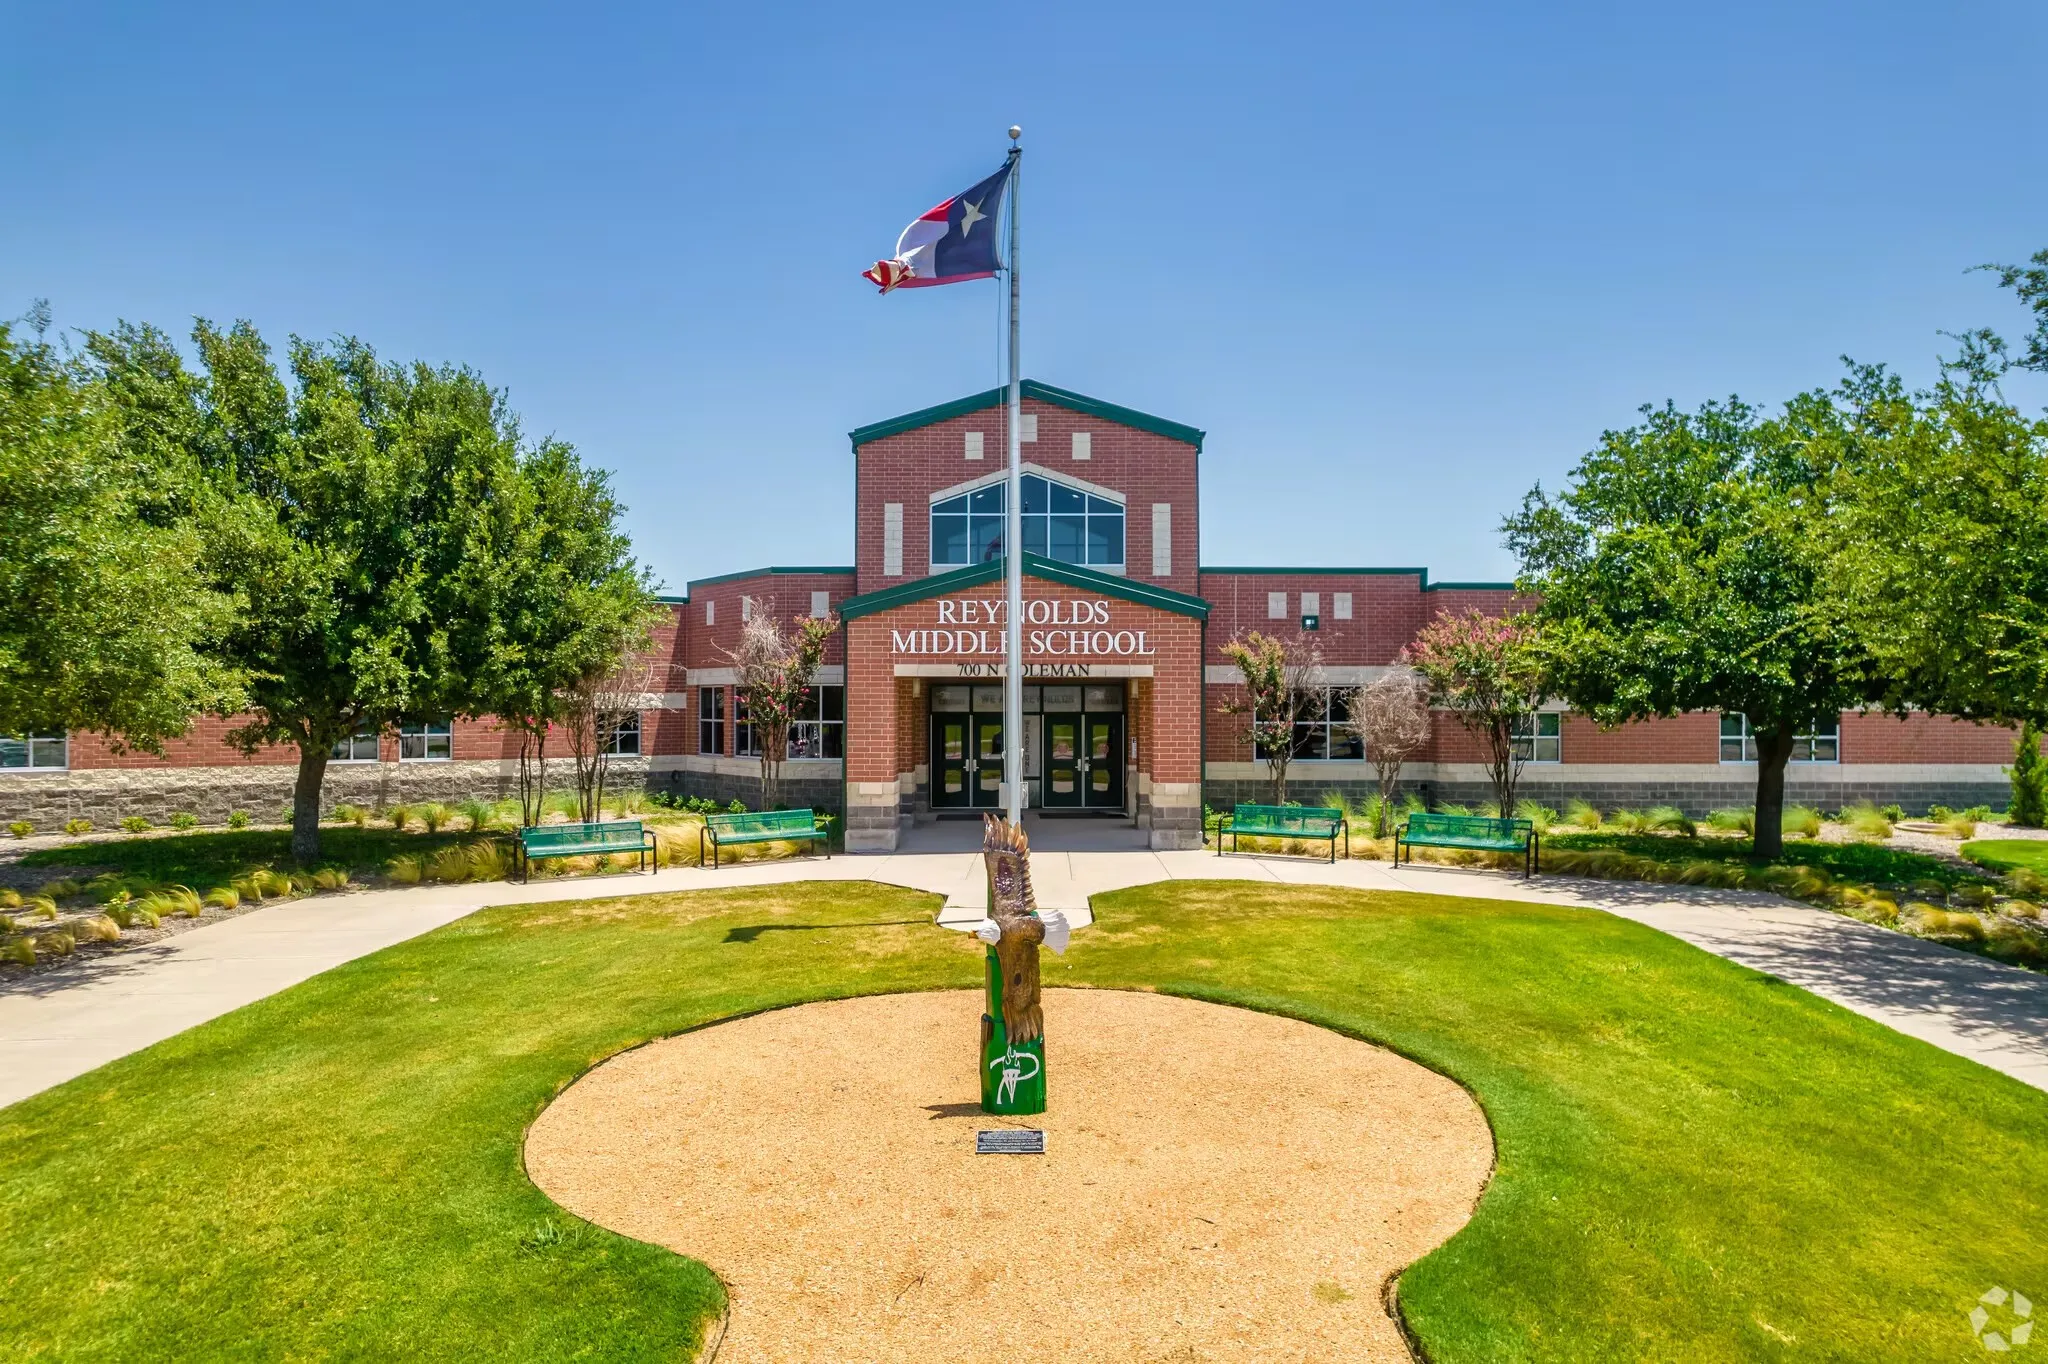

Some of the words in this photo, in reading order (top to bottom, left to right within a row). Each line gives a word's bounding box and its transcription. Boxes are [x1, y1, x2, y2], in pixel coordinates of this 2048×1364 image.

[1030, 630, 1156, 655] SCHOOL
[957, 663, 981, 676] 700
[987, 663, 999, 676] N
[1006, 663, 1090, 676] OLEMAN
